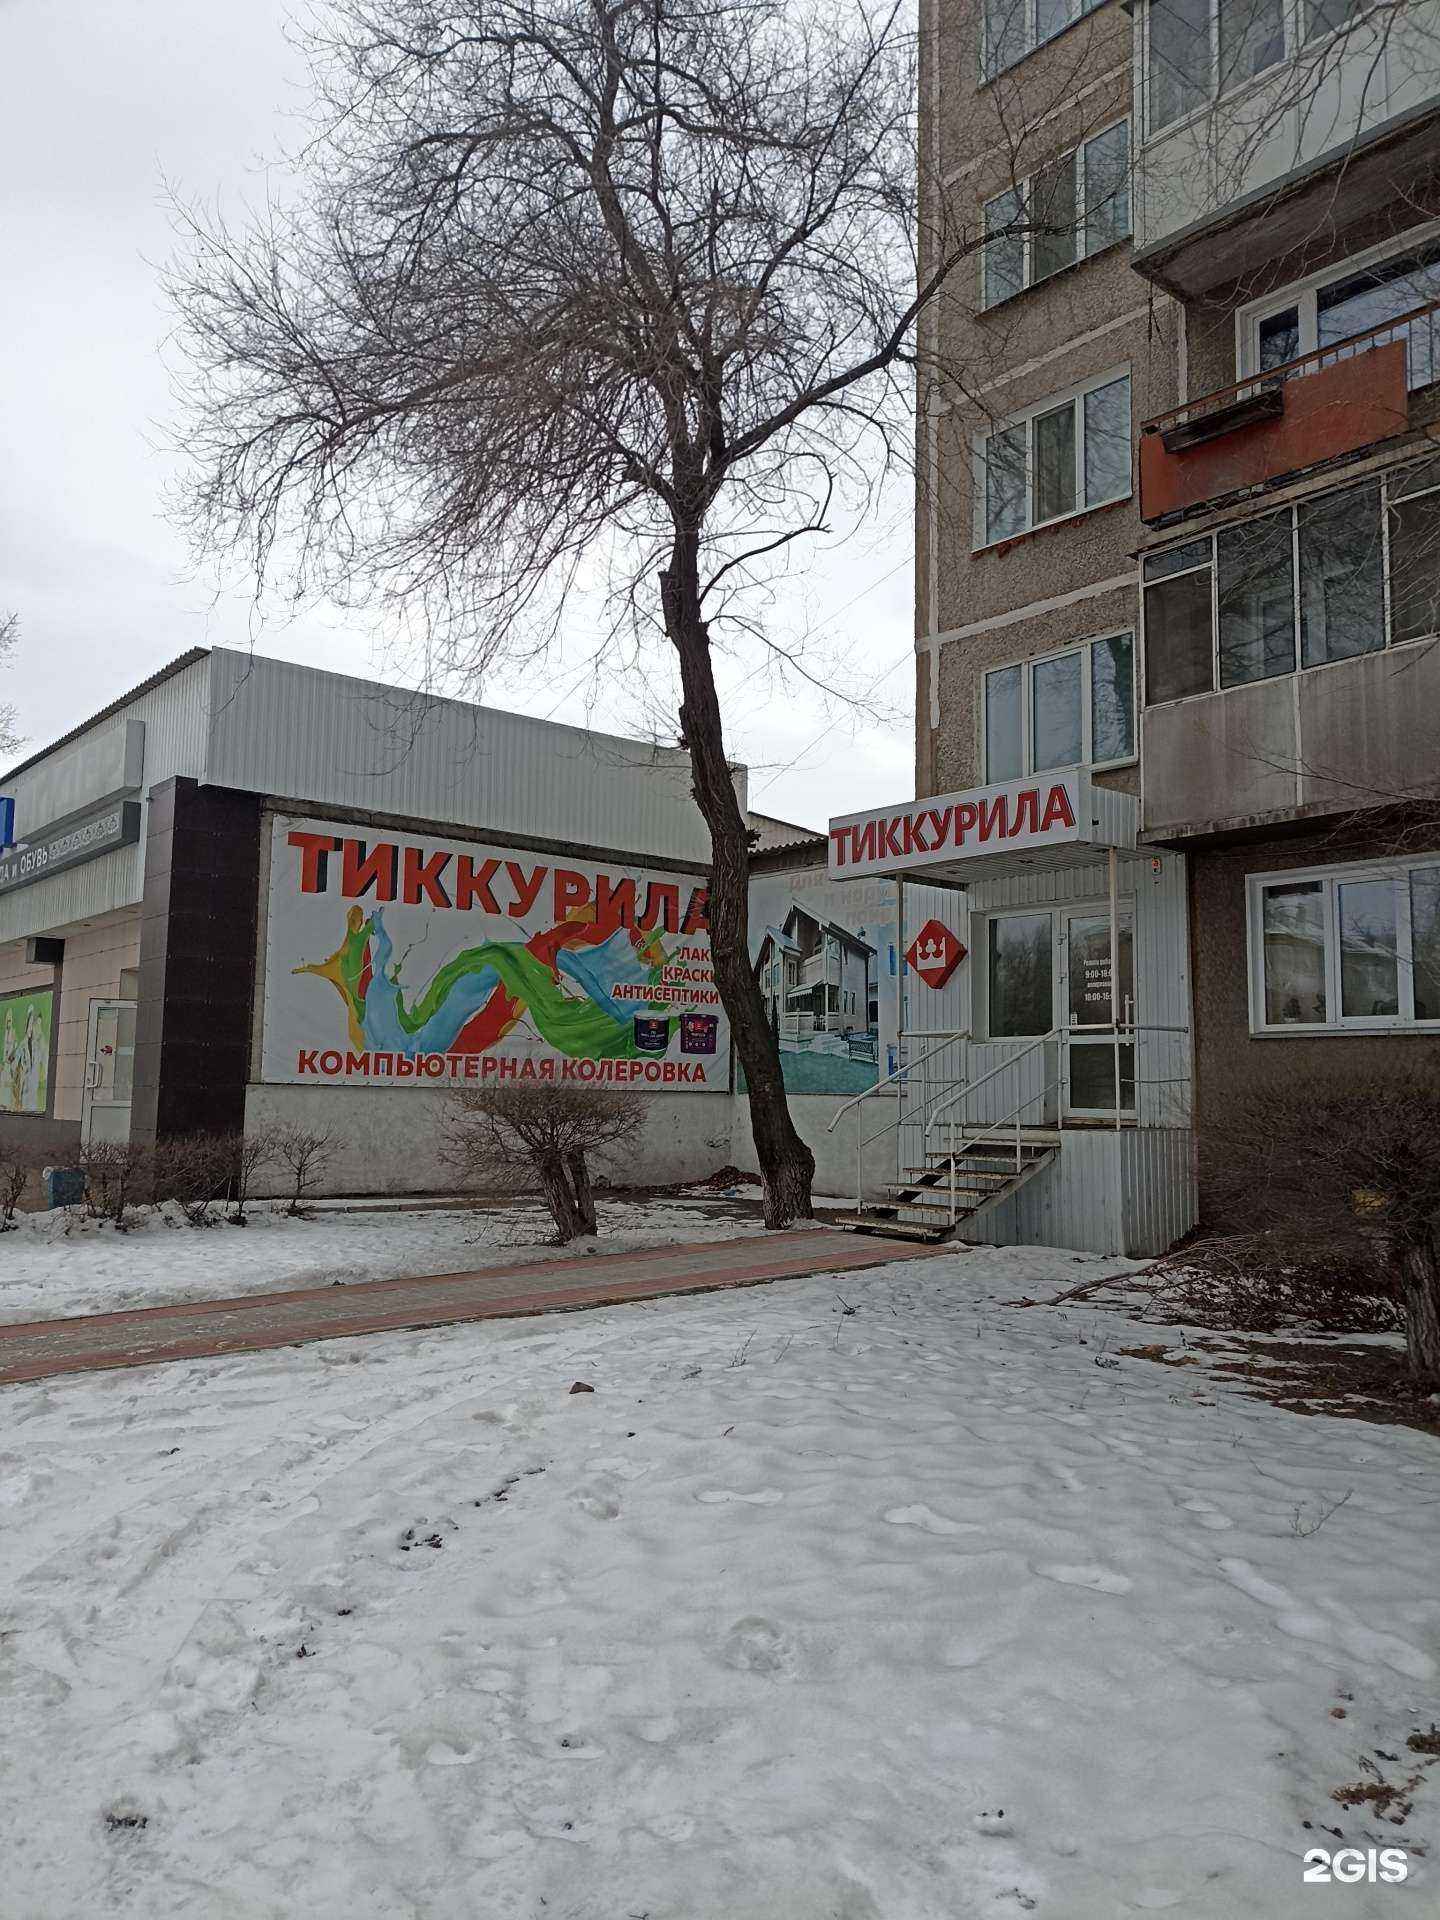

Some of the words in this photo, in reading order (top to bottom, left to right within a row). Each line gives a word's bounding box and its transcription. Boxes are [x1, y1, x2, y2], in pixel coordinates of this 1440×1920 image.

[830, 783, 1077, 866] ТИККУРИЛА
[20, 846, 48, 874] ОБУВЬ
[680, 947, 711, 962] ЛАК
[611, 984, 719, 1004] АНТИСЕПТИКИ
[297, 1049, 555, 1080] КОМПЬЮТЕРНАЯ
[561, 1057, 708, 1083] КОЛЕРОВКА
